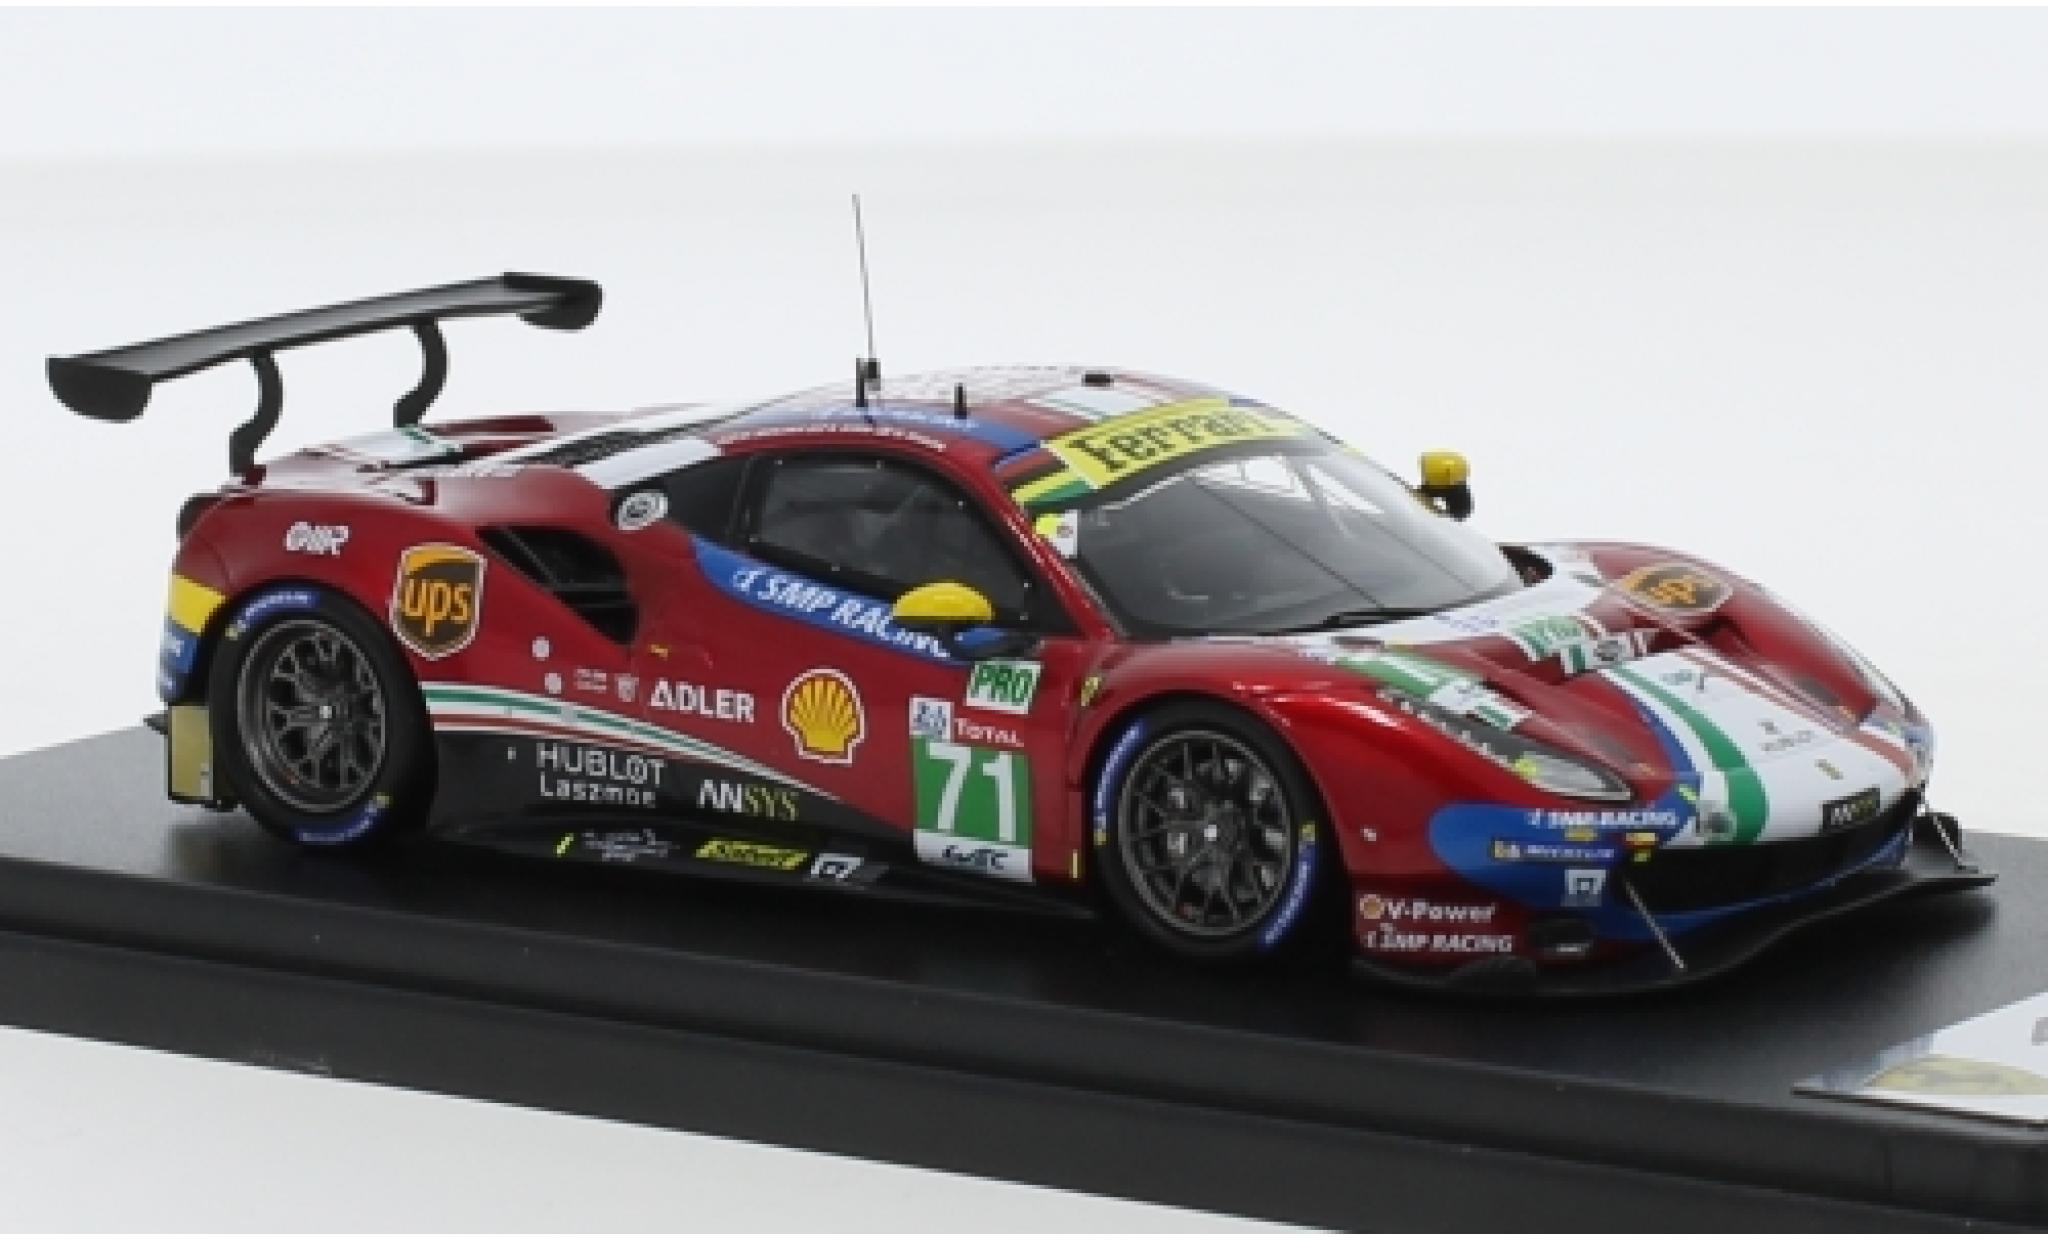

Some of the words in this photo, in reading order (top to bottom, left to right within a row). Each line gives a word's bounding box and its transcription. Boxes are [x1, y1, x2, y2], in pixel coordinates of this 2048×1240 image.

[1066, 410, 1273, 473] Ferrari
[404, 578, 473, 637] ups
[757, 574, 837, 613] SMP
[650, 677, 756, 724] ADLER
[970, 663, 1034, 707] PRO
[955, 717, 1026, 748] TOTAL
[536, 742, 667, 788] HUBLOT
[697, 778, 801, 822] ANSYS
[928, 743, 1018, 842] 71
[1600, 809, 1679, 829] RACING
[1387, 898, 1497, 924] V-Power
[1431, 933, 1514, 953] RACING
